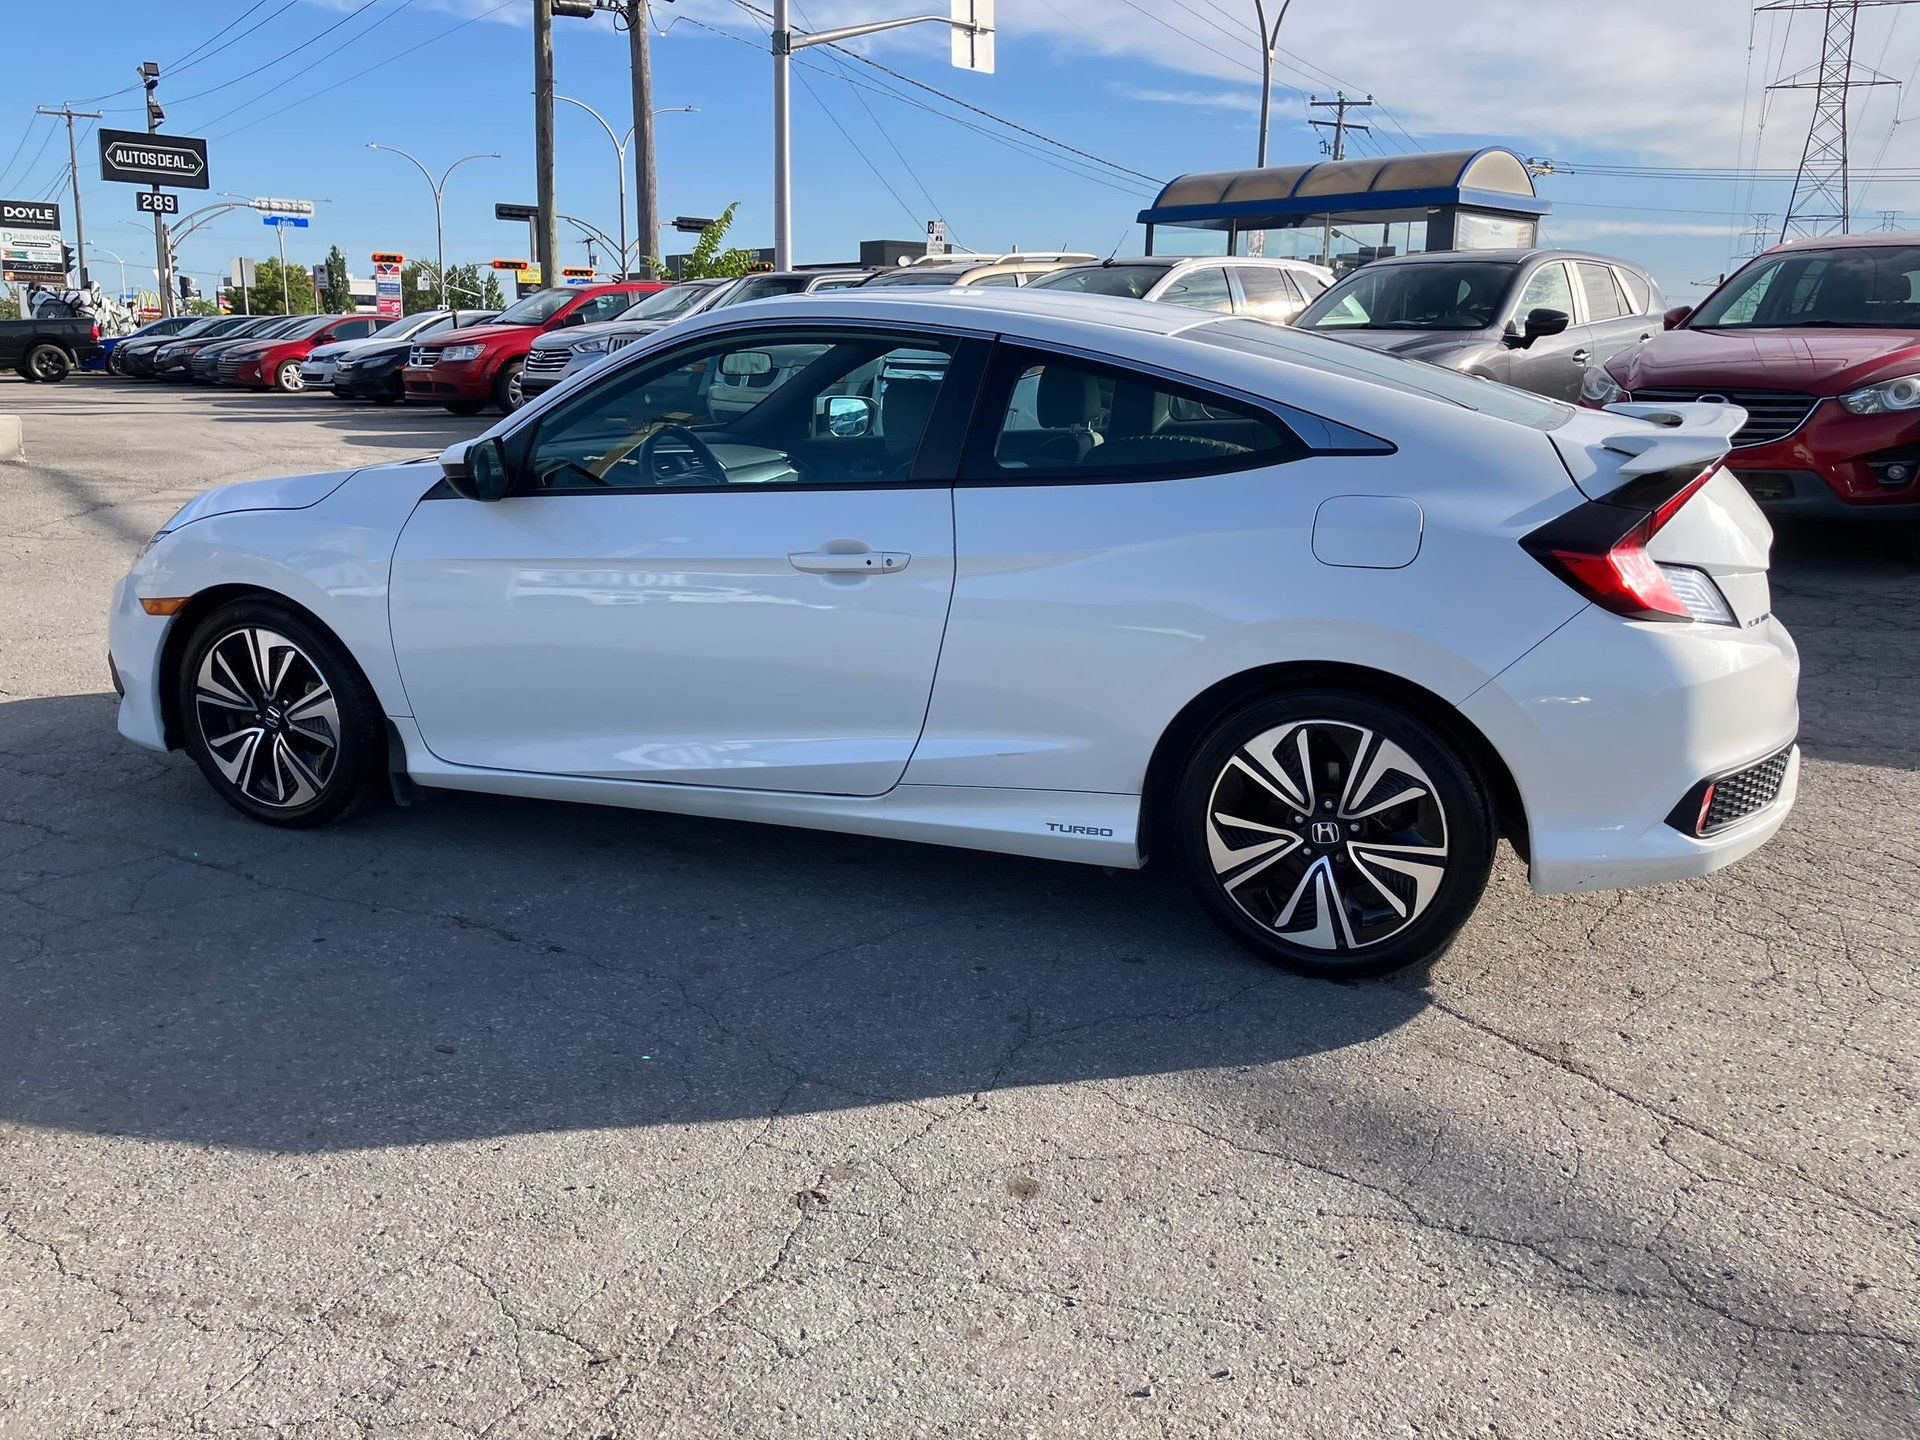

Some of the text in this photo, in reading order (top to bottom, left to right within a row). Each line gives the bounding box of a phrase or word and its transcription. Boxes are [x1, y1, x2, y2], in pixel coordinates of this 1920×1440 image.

[142, 194, 175, 212] 289
[3, 206, 54, 220] DOYLE
[1045, 822, 1114, 837] TURBO
